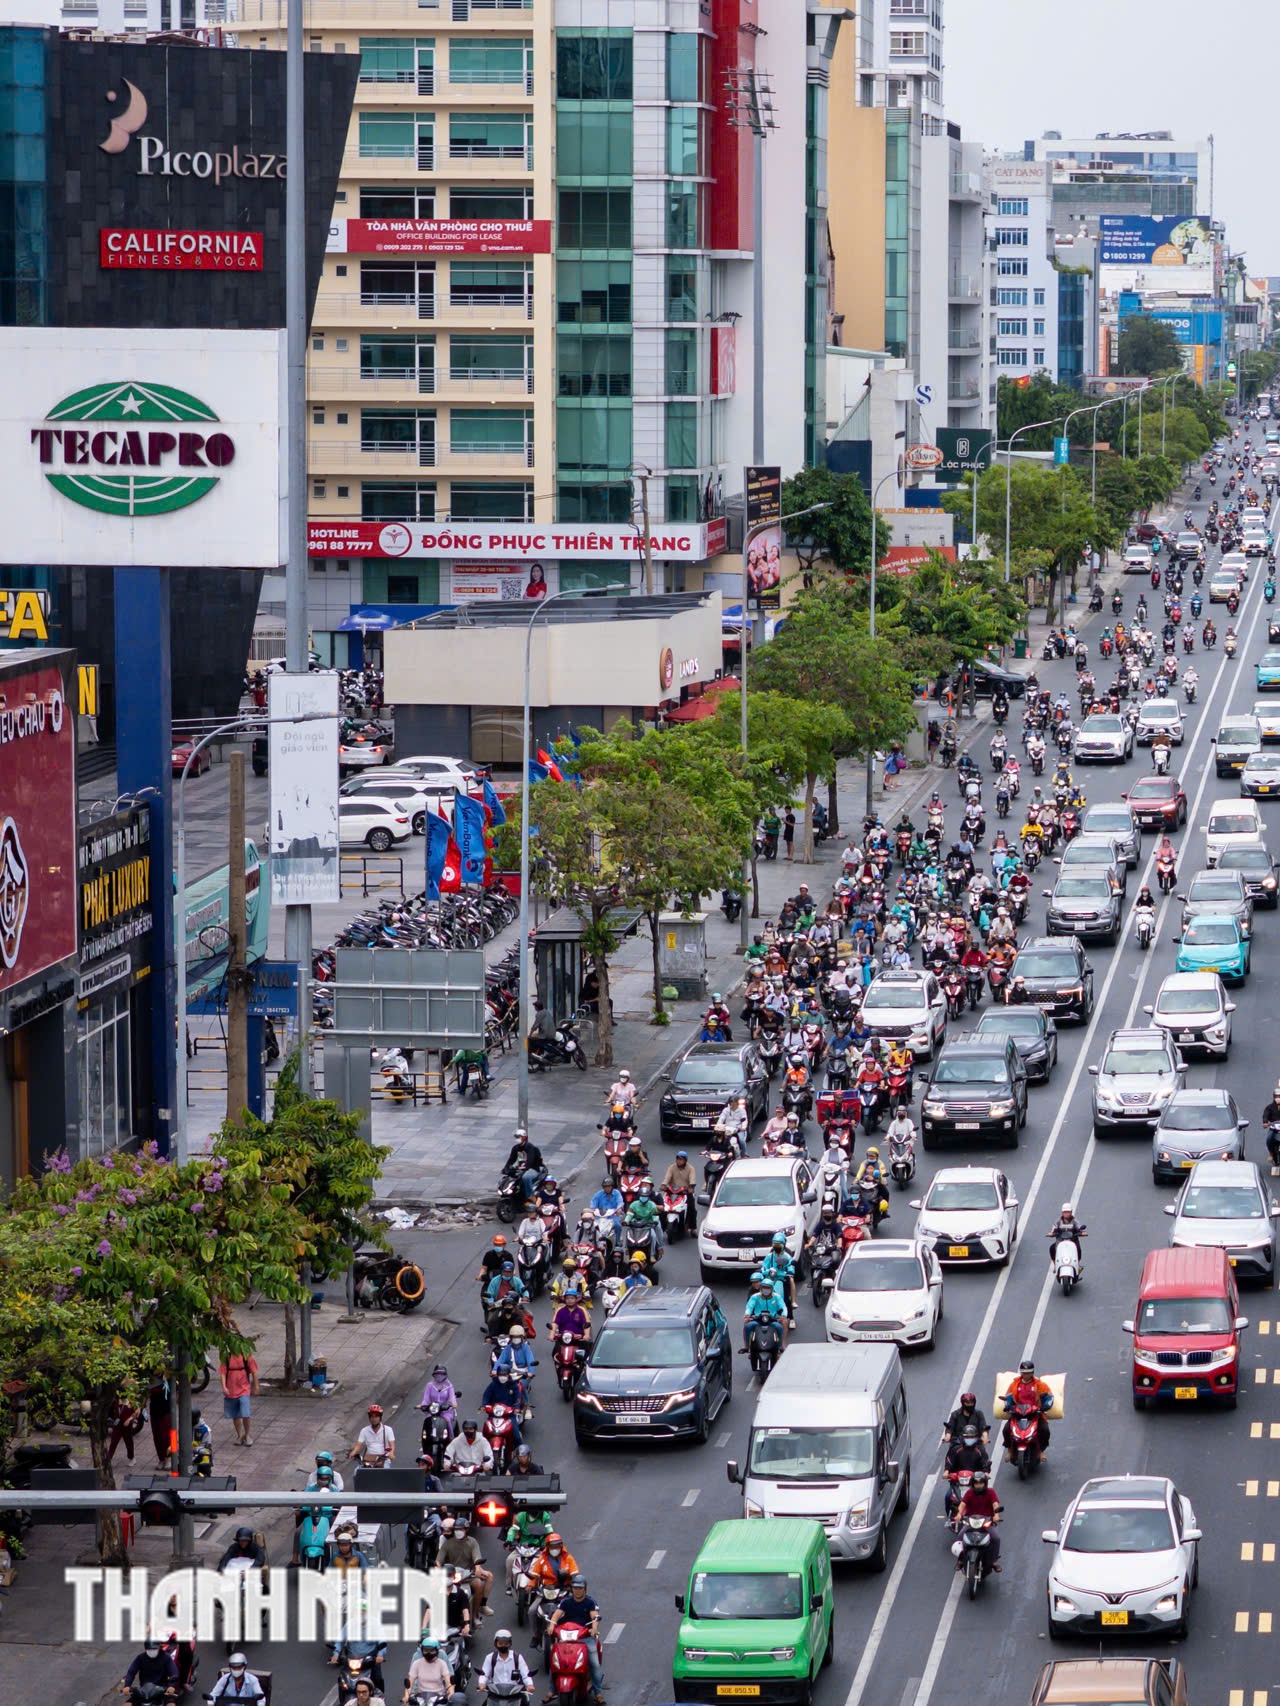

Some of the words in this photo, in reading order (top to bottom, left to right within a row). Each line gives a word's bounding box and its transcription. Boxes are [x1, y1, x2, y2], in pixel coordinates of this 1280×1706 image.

[136, 136, 288, 186] Picoplaza
[366, 220, 388, 231] TÒA
[390, 220, 413, 231] NHÀ
[415, 220, 438, 231] VĂN
[440, 221, 477, 232] PHÒNG
[480, 223, 503, 232] CHO
[505, 221, 533, 232] THUÊ
[106, 232, 257, 254] CALIFORNIA
[107, 254, 182, 266] FITNESS
[194, 255, 202, 266] &
[213, 255, 258, 267] YOGA
[30, 429, 236, 467] TECAPRO
[310, 529, 359, 538] HOTLINE
[421, 529, 482, 549] ĐỒNG
[489, 534, 546, 554] PHỤC
[552, 532, 613, 550] THIÊN
[620, 536, 691, 551] TRANG
[329, 541, 344, 550] 88
[346, 541, 373, 550] 7777
[112, 855, 150, 918] LUXURY
